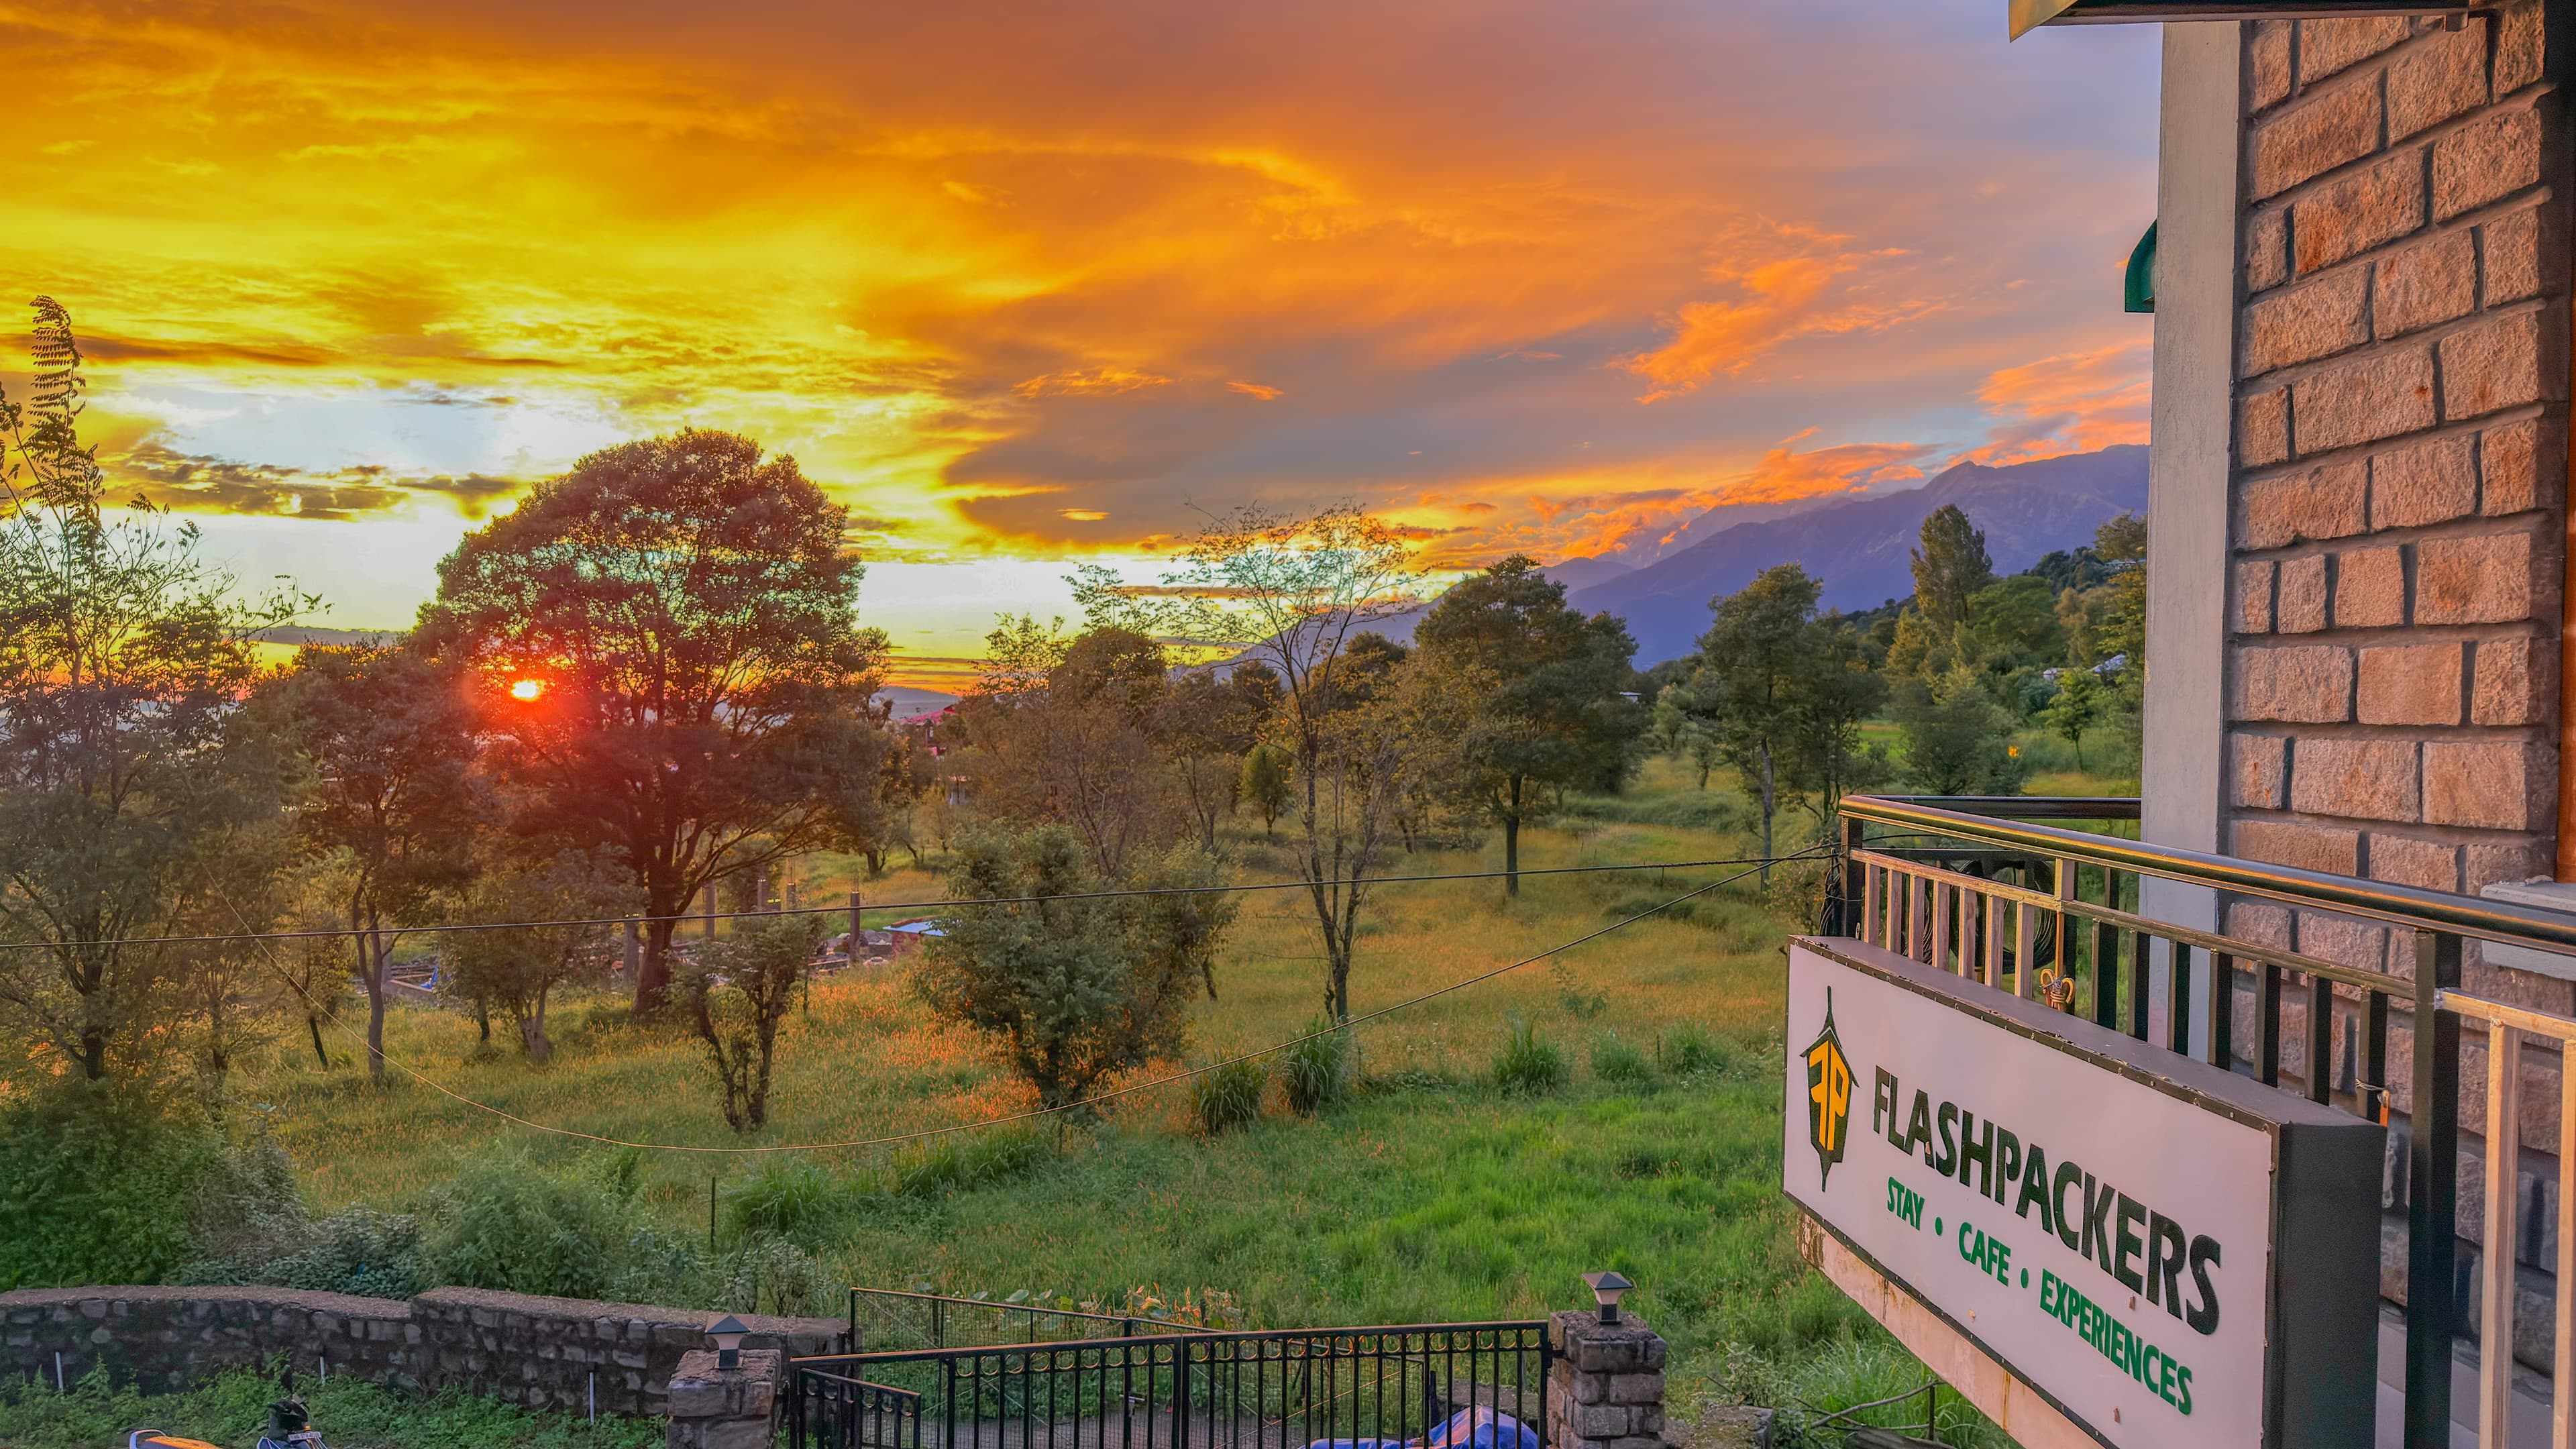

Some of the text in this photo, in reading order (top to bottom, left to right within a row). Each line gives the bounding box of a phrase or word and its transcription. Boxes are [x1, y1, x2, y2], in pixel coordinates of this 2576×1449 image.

[1873, 1065, 2221, 1336] FLASHPACKERS
[1887, 1176, 2193, 1416] STAY CAFE EXPERIENCES
